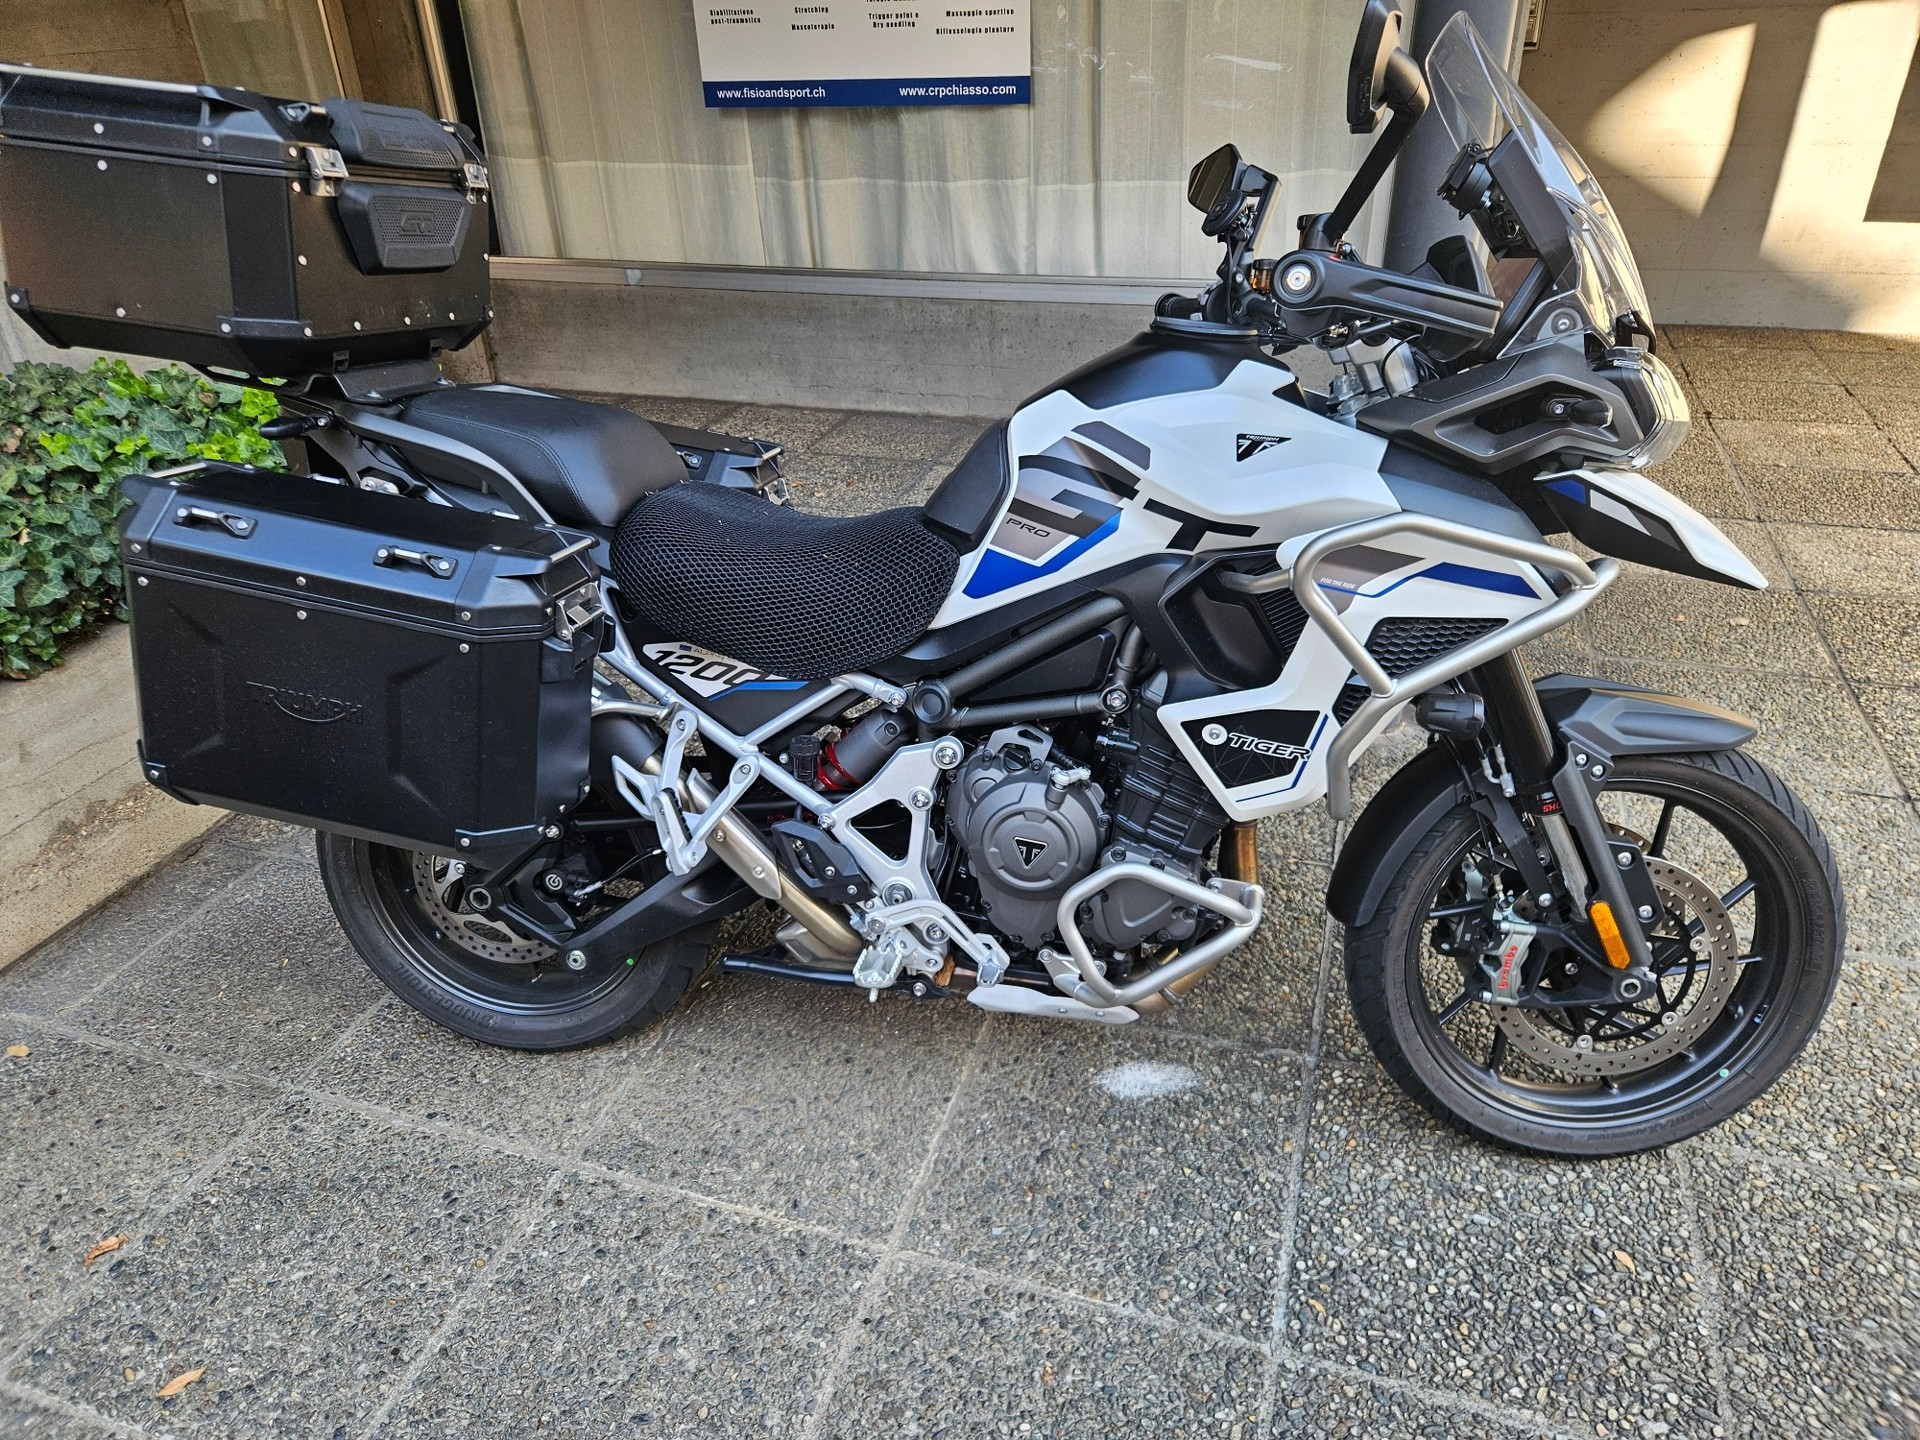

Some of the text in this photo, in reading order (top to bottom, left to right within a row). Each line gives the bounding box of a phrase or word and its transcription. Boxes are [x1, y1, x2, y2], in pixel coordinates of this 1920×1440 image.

[794, 6, 829, 14] Stretching
[868, 12, 893, 20] Trigger
[945, 8, 1014, 17] Massaggio sportivo
[791, 23, 835, 31] Massoterapia
[984, 26, 1014, 34] plantare
[716, 87, 826, 100] www.fisioandsport.ch
[899, 83, 1016, 98] www.crpchiasso.com
[1006, 517, 1051, 538] PRO
[655, 650, 768, 687] 1200
[246, 681, 364, 725] TRIUMPH
[1228, 732, 1313, 761] TIGER
[1498, 946, 1518, 989] brembo
